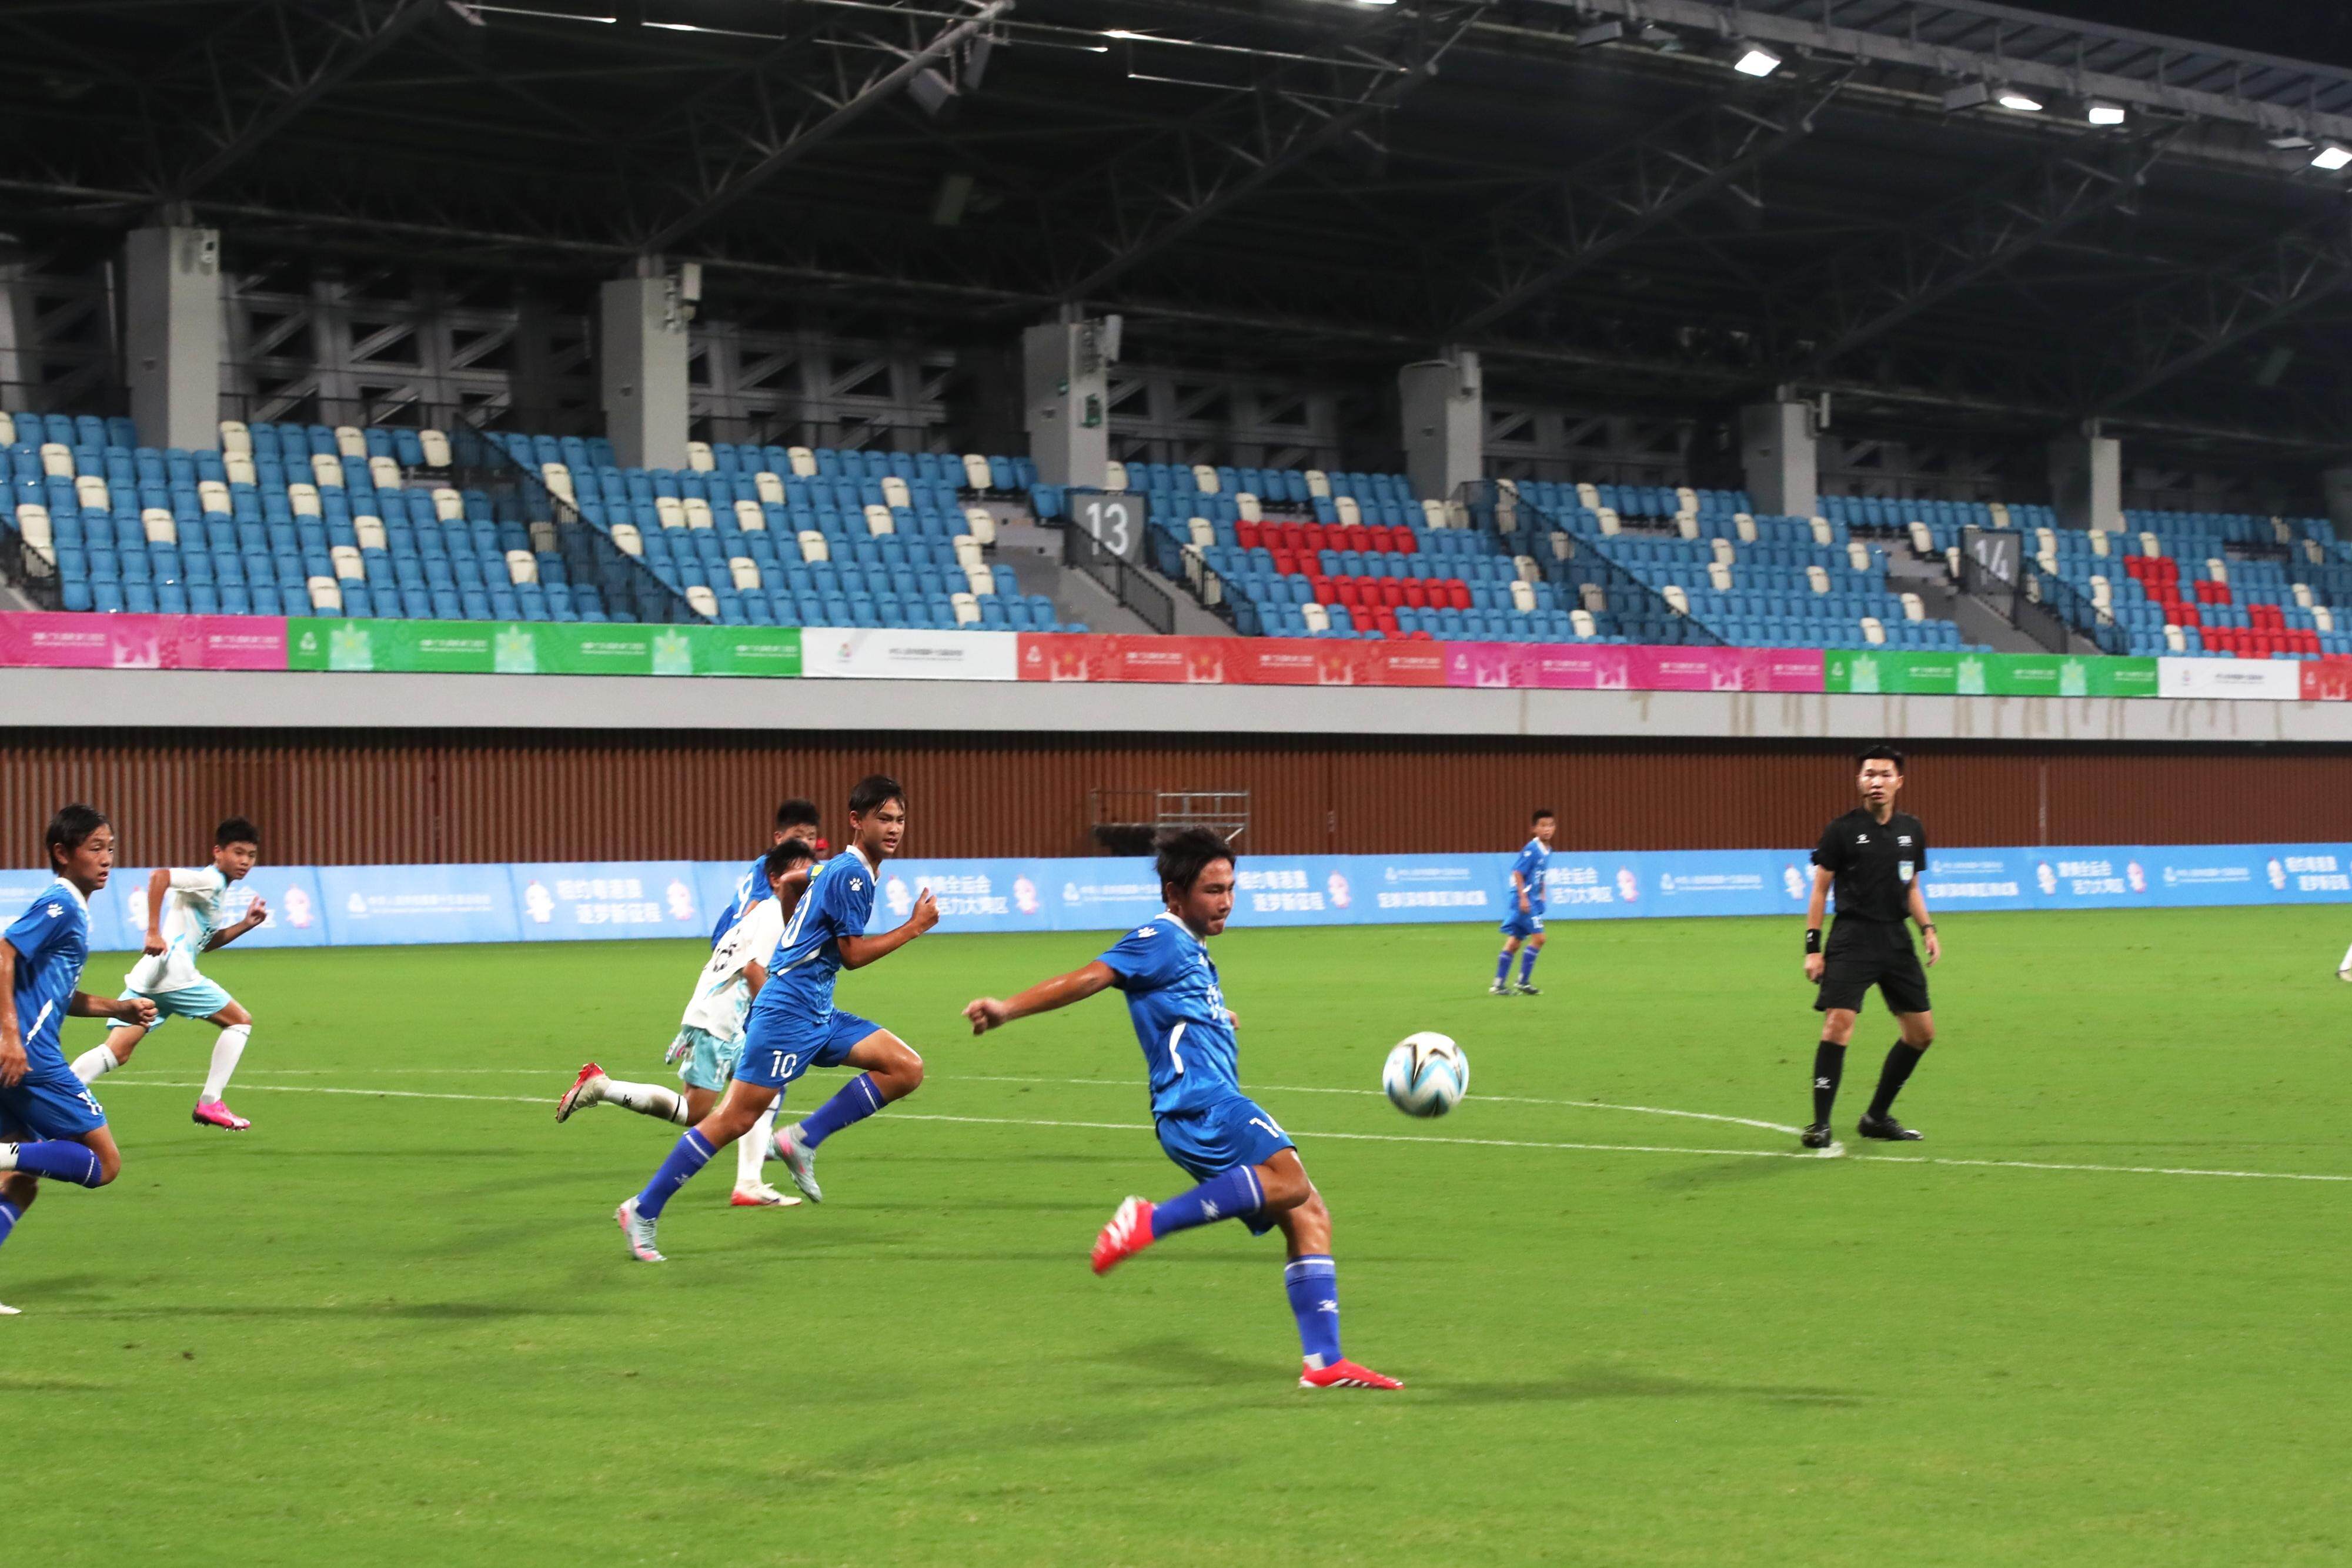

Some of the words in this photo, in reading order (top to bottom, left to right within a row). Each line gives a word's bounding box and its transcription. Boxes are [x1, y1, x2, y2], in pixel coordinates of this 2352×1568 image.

[1085, 502, 1128, 556] 13
[1975, 539, 2009, 584] 14
[770, 1049, 797, 1078] 10
